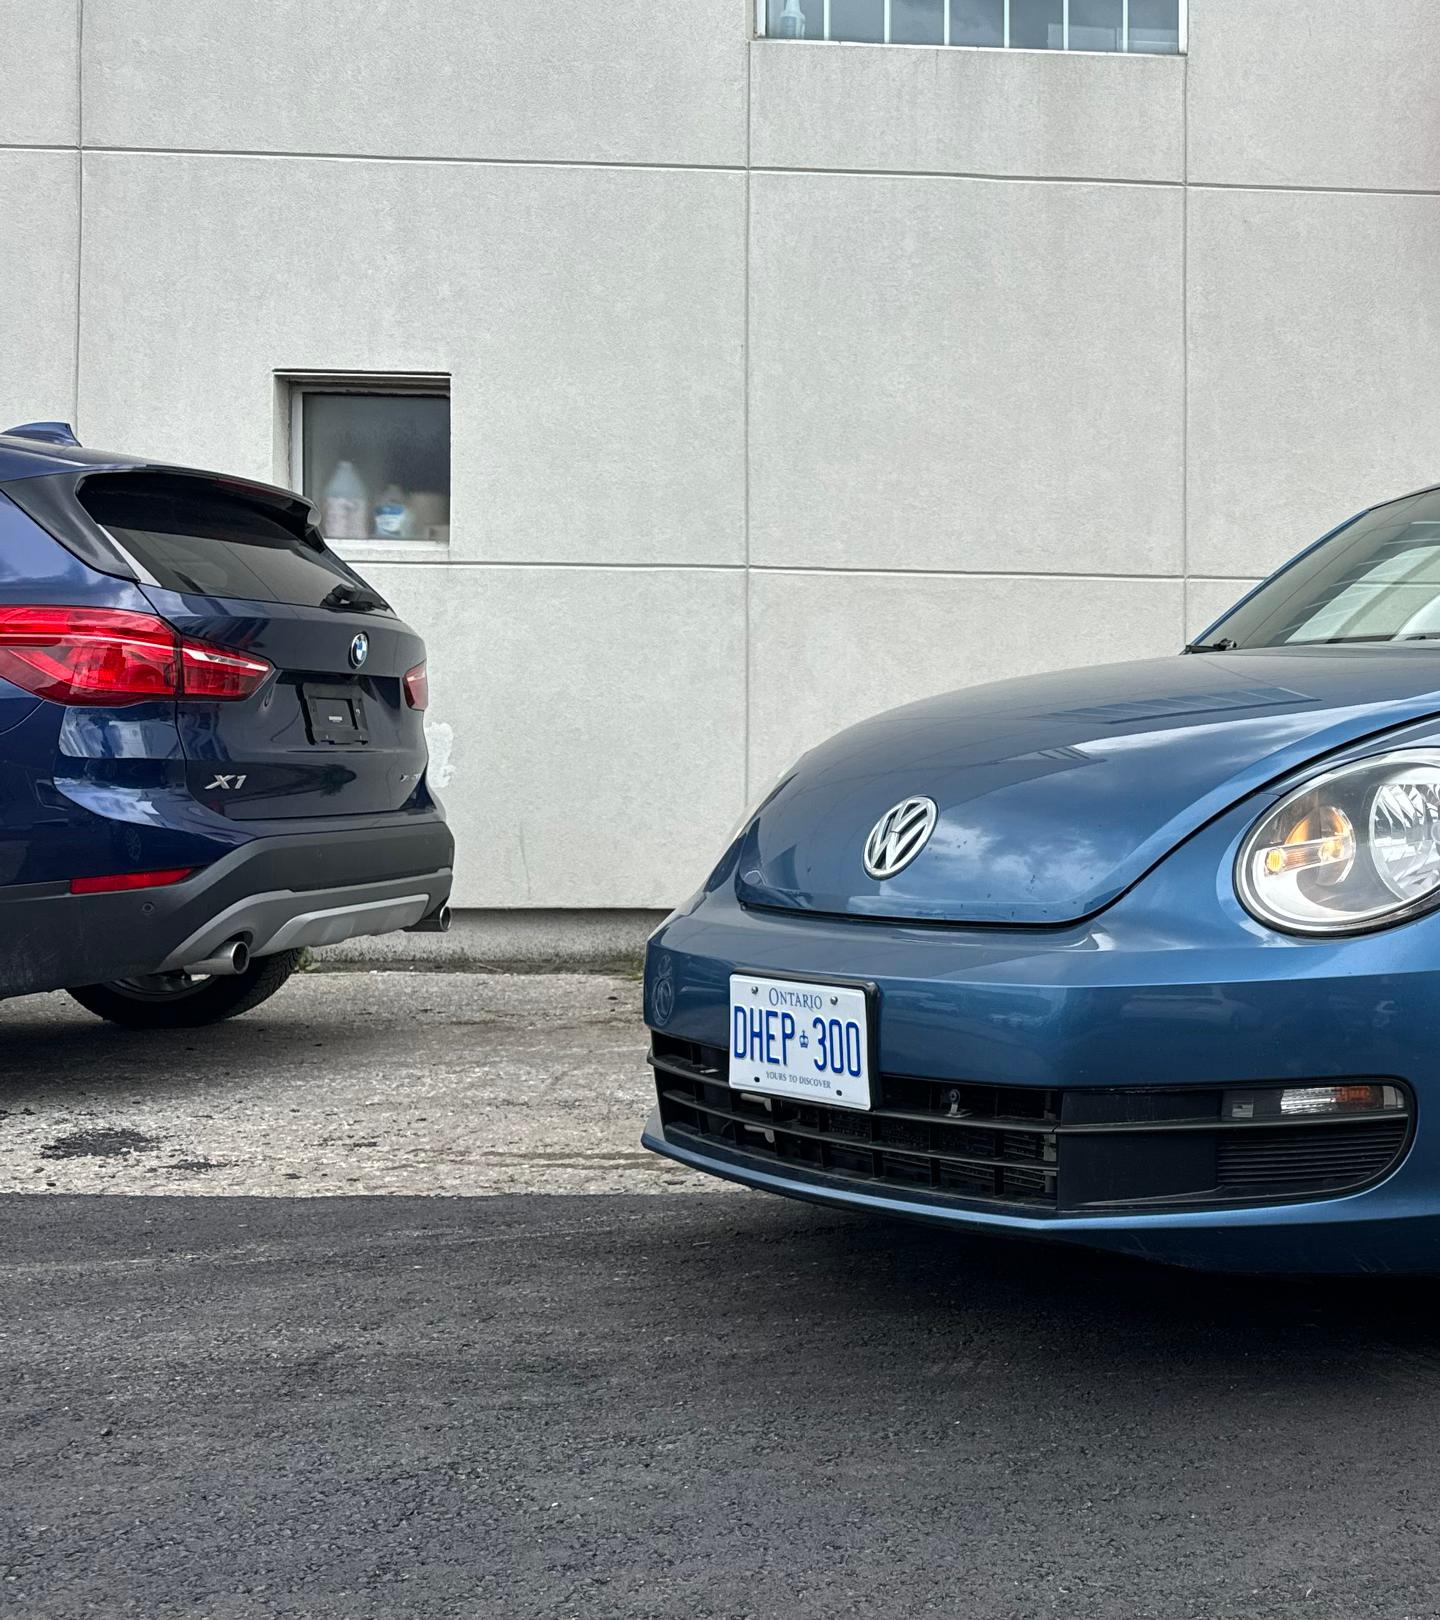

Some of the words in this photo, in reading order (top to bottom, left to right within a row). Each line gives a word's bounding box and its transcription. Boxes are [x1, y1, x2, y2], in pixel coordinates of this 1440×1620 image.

[204, 774, 247, 789] X1
[769, 987, 823, 1011] ONTARIO
[734, 1005, 796, 1066] DHEP
[812, 1017, 861, 1077] 300
[766, 1071, 787, 1082] YOURS
[788, 1074, 798, 1083] TO
[799, 1075, 831, 1089] DISCOVER
